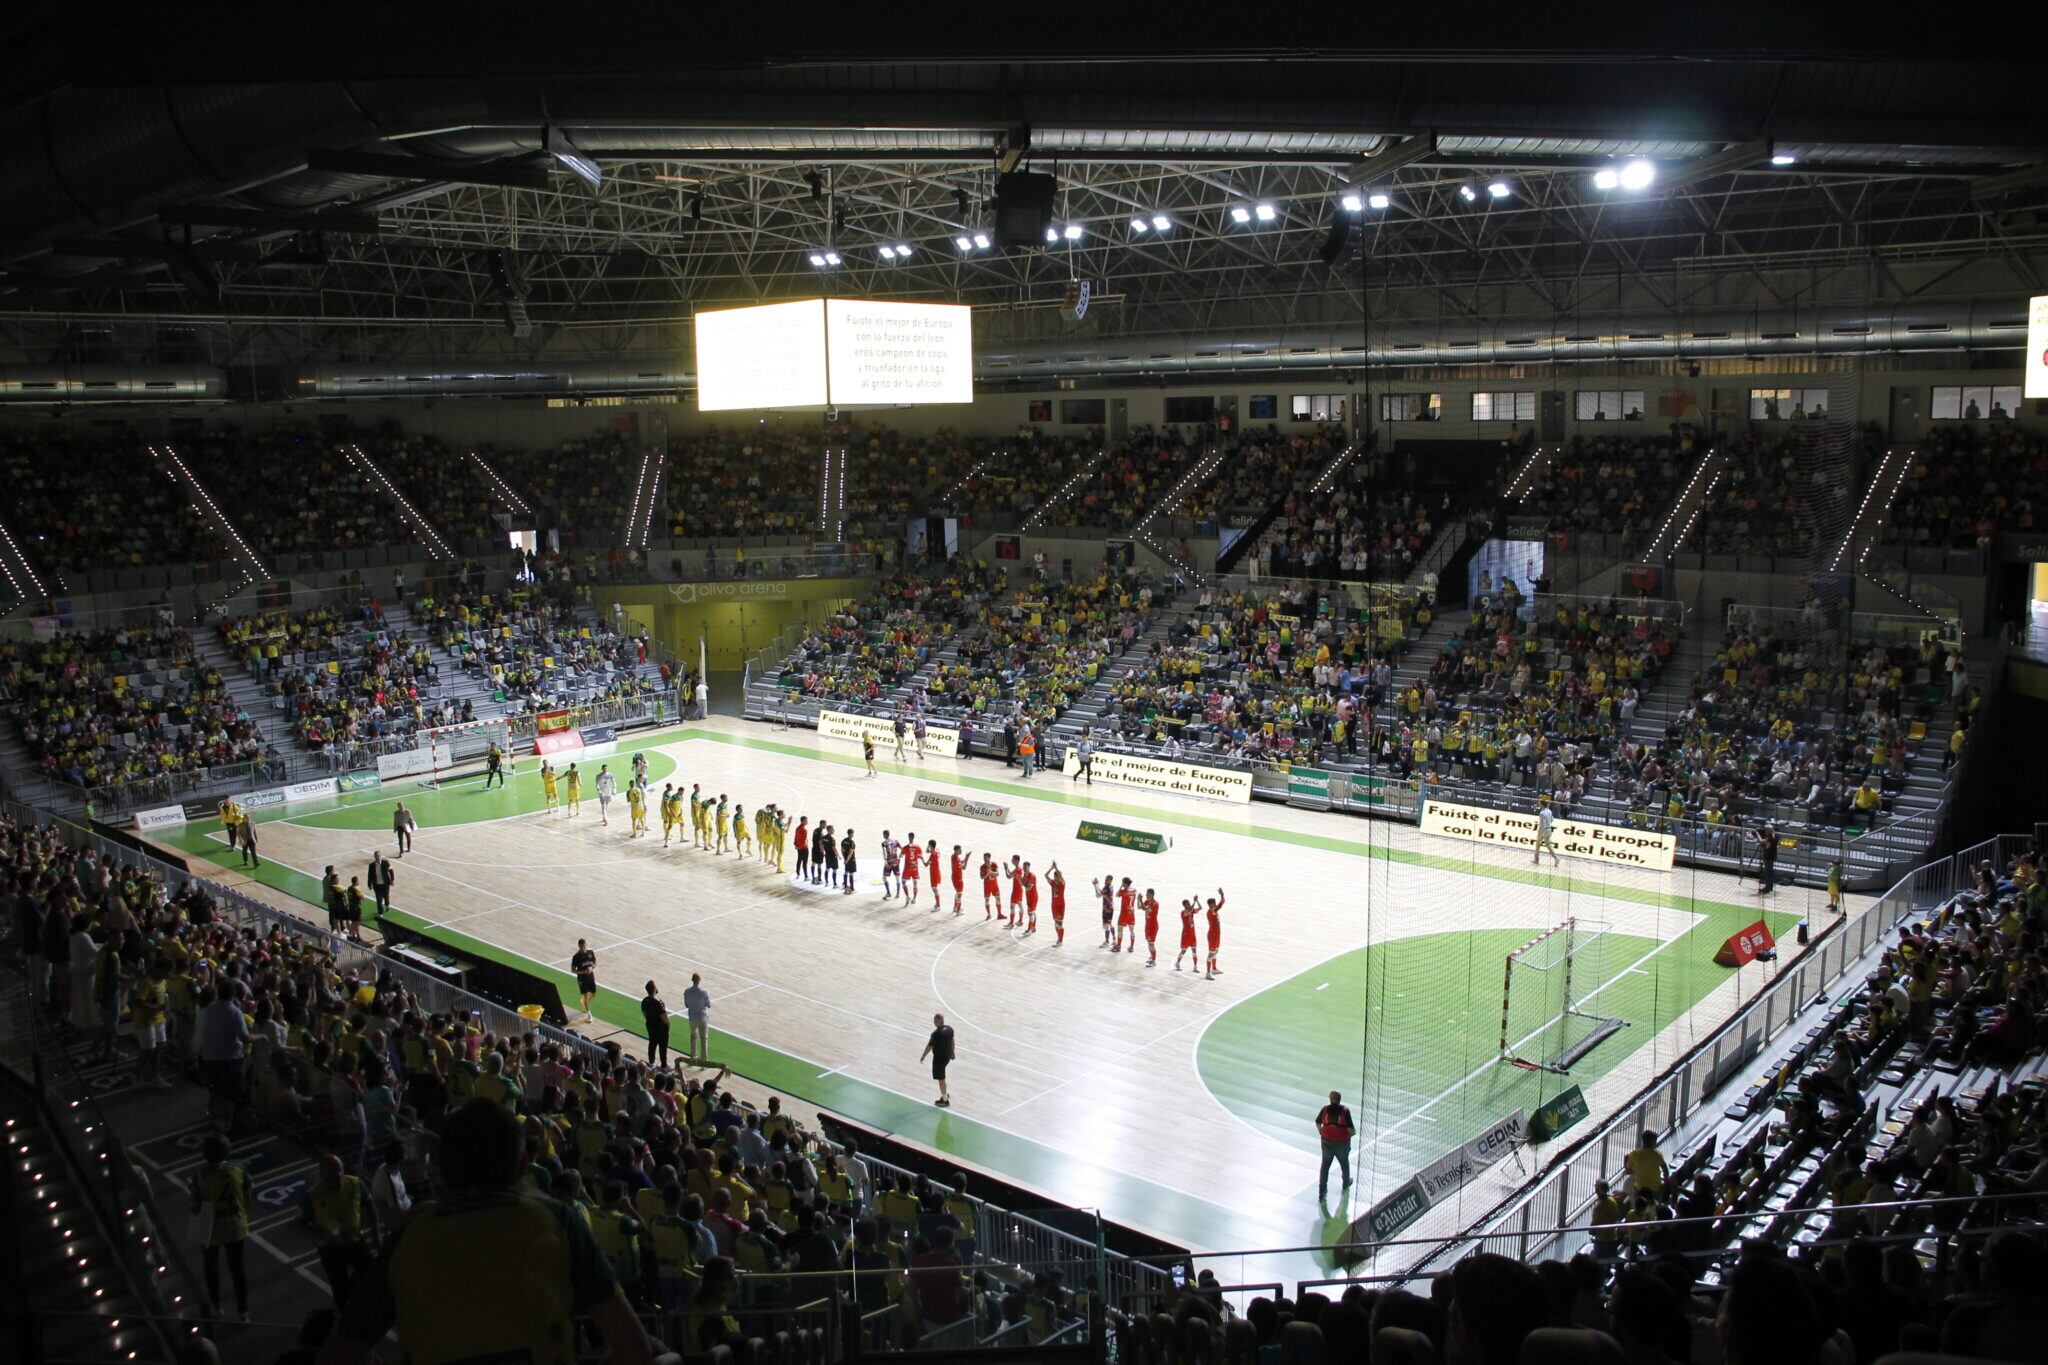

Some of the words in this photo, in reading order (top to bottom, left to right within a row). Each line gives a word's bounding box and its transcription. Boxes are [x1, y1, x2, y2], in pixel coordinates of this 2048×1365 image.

[847, 314, 873, 326] Fuiste
[875, 315, 883, 326] el
[885, 319, 910, 329] mejor
[912, 317, 922, 328] de
[856, 333, 871, 341] con
[874, 331, 882, 341] la
[884, 331, 911, 342] fuerza
[913, 332, 925, 343] del
[854, 349, 873, 357] eres
[916, 348, 925, 357] de
[920, 364, 928, 373] la
[871, 379, 891, 391] grito
[893, 379, 902, 388] de
[699, 583, 736, 597] olivo
[740, 583, 786, 594] arena
[822, 713, 851, 725] Fuiste
[853, 719, 862, 727] el
[926, 731, 955, 743] ropa,
[830, 728, 847, 736] con
[849, 728, 859, 738] la
[1069, 752, 1108, 765] Fste
[1111, 756, 1123, 767] el
[1126, 762, 1165, 774] mejor
[1169, 766, 1187, 777] de
[1191, 769, 1247, 787] Europa,
[1106, 770, 1119, 780] la
[1122, 772, 1166, 787] fuerza
[1170, 780, 1192, 791] del
[1196, 784, 1230, 798] león,
[918, 793, 949, 807] cajasur
[963, 803, 995, 816] cajasur
[150, 811, 182, 825] Tecniseg
[1427, 805, 1479, 821] Fuiste
[1484, 814, 1499, 825] el
[1505, 817, 1557, 833] mejr
[1563, 825, 1586, 838] de
[1592, 829, 1669, 851] Europa,
[1443, 823, 1473, 835] con
[1478, 828, 1495, 839] la
[1565, 842, 1593, 855] del
[1599, 846, 1645, 864] león,
[1478, 1118, 1521, 1154] OEDIM
[1433, 1160, 1473, 1190] Tecniseg
